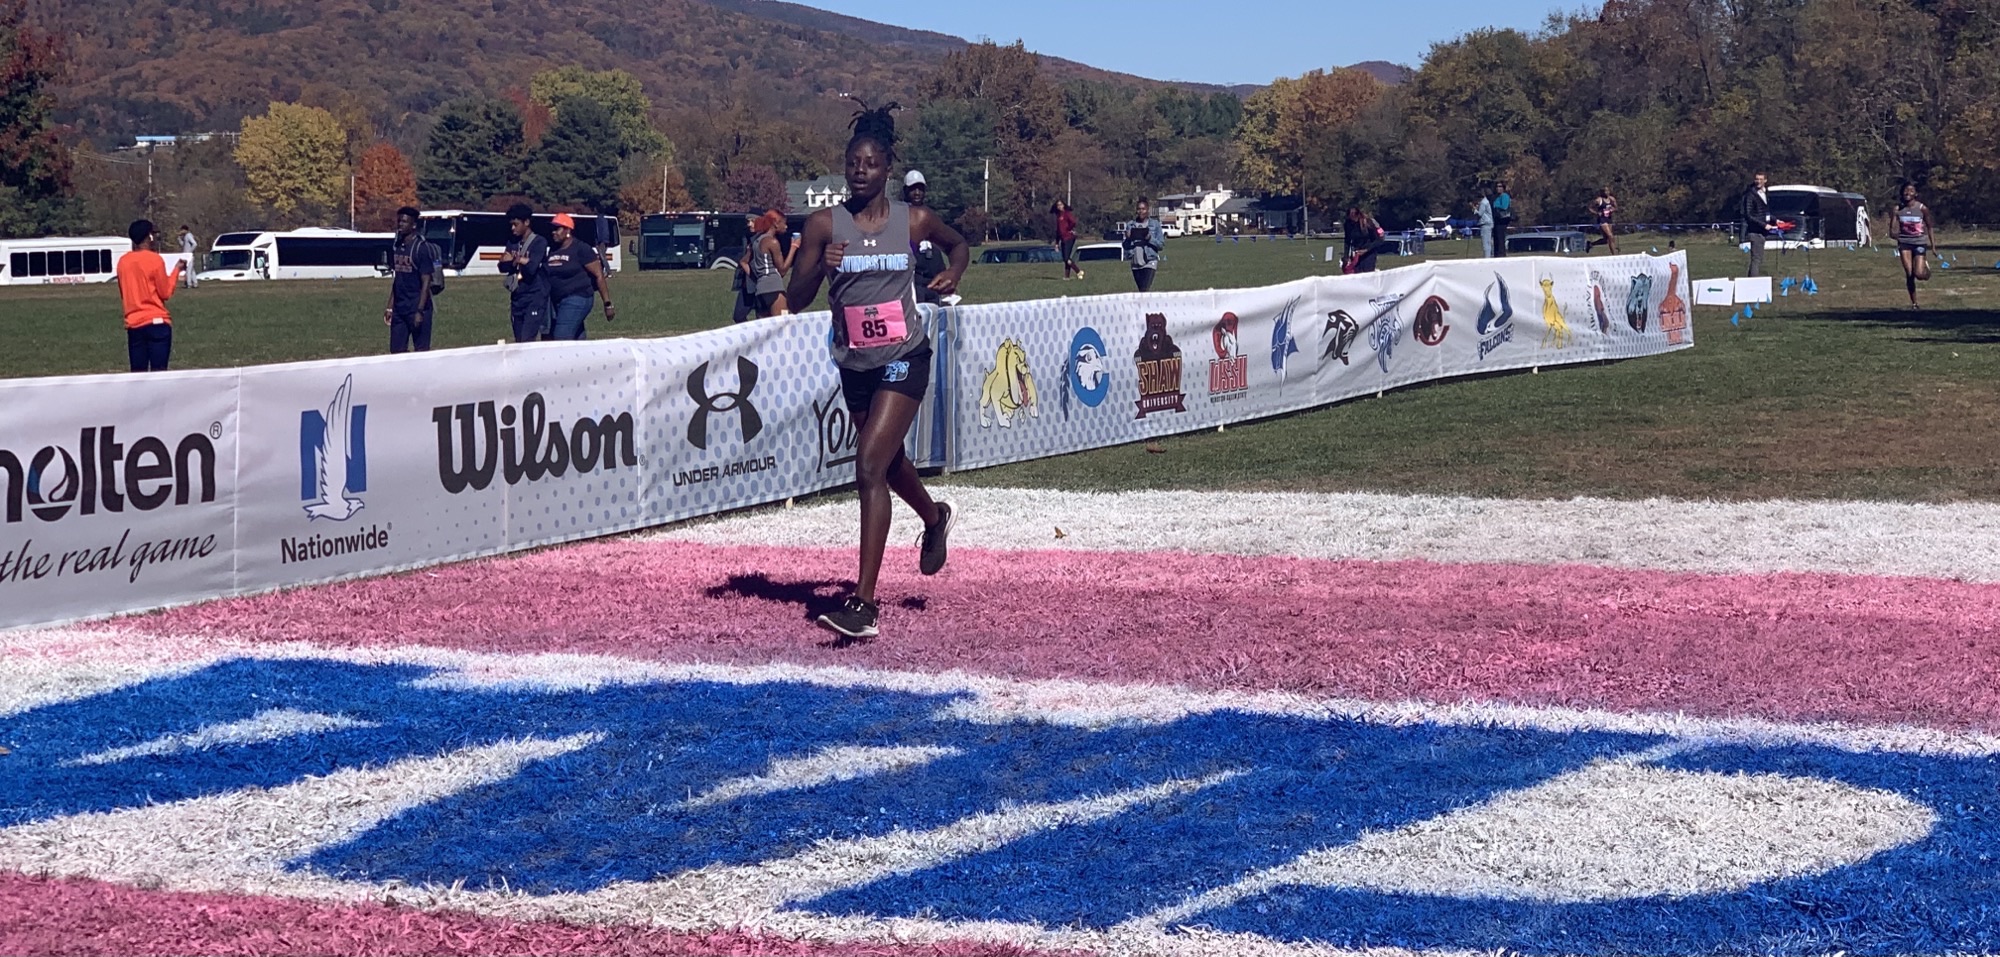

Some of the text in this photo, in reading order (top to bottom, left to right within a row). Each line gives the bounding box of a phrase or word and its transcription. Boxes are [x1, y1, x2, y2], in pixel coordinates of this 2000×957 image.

[836, 253, 909, 273] IVINGSTONE
[861, 319, 888, 339] 85
[1477, 322, 1515, 361] FALCONS
[1137, 357, 1182, 396] SHAW
[1209, 354, 1248, 395] WSSU
[1142, 395, 1179, 409] UNIVERSITY
[433, 392, 637, 494] Wilson
[673, 455, 776, 487] UNDER ARMOUR
[57, 528, 131, 578] real
[129, 533, 217, 584] game
[281, 526, 389, 564] Nationwide
